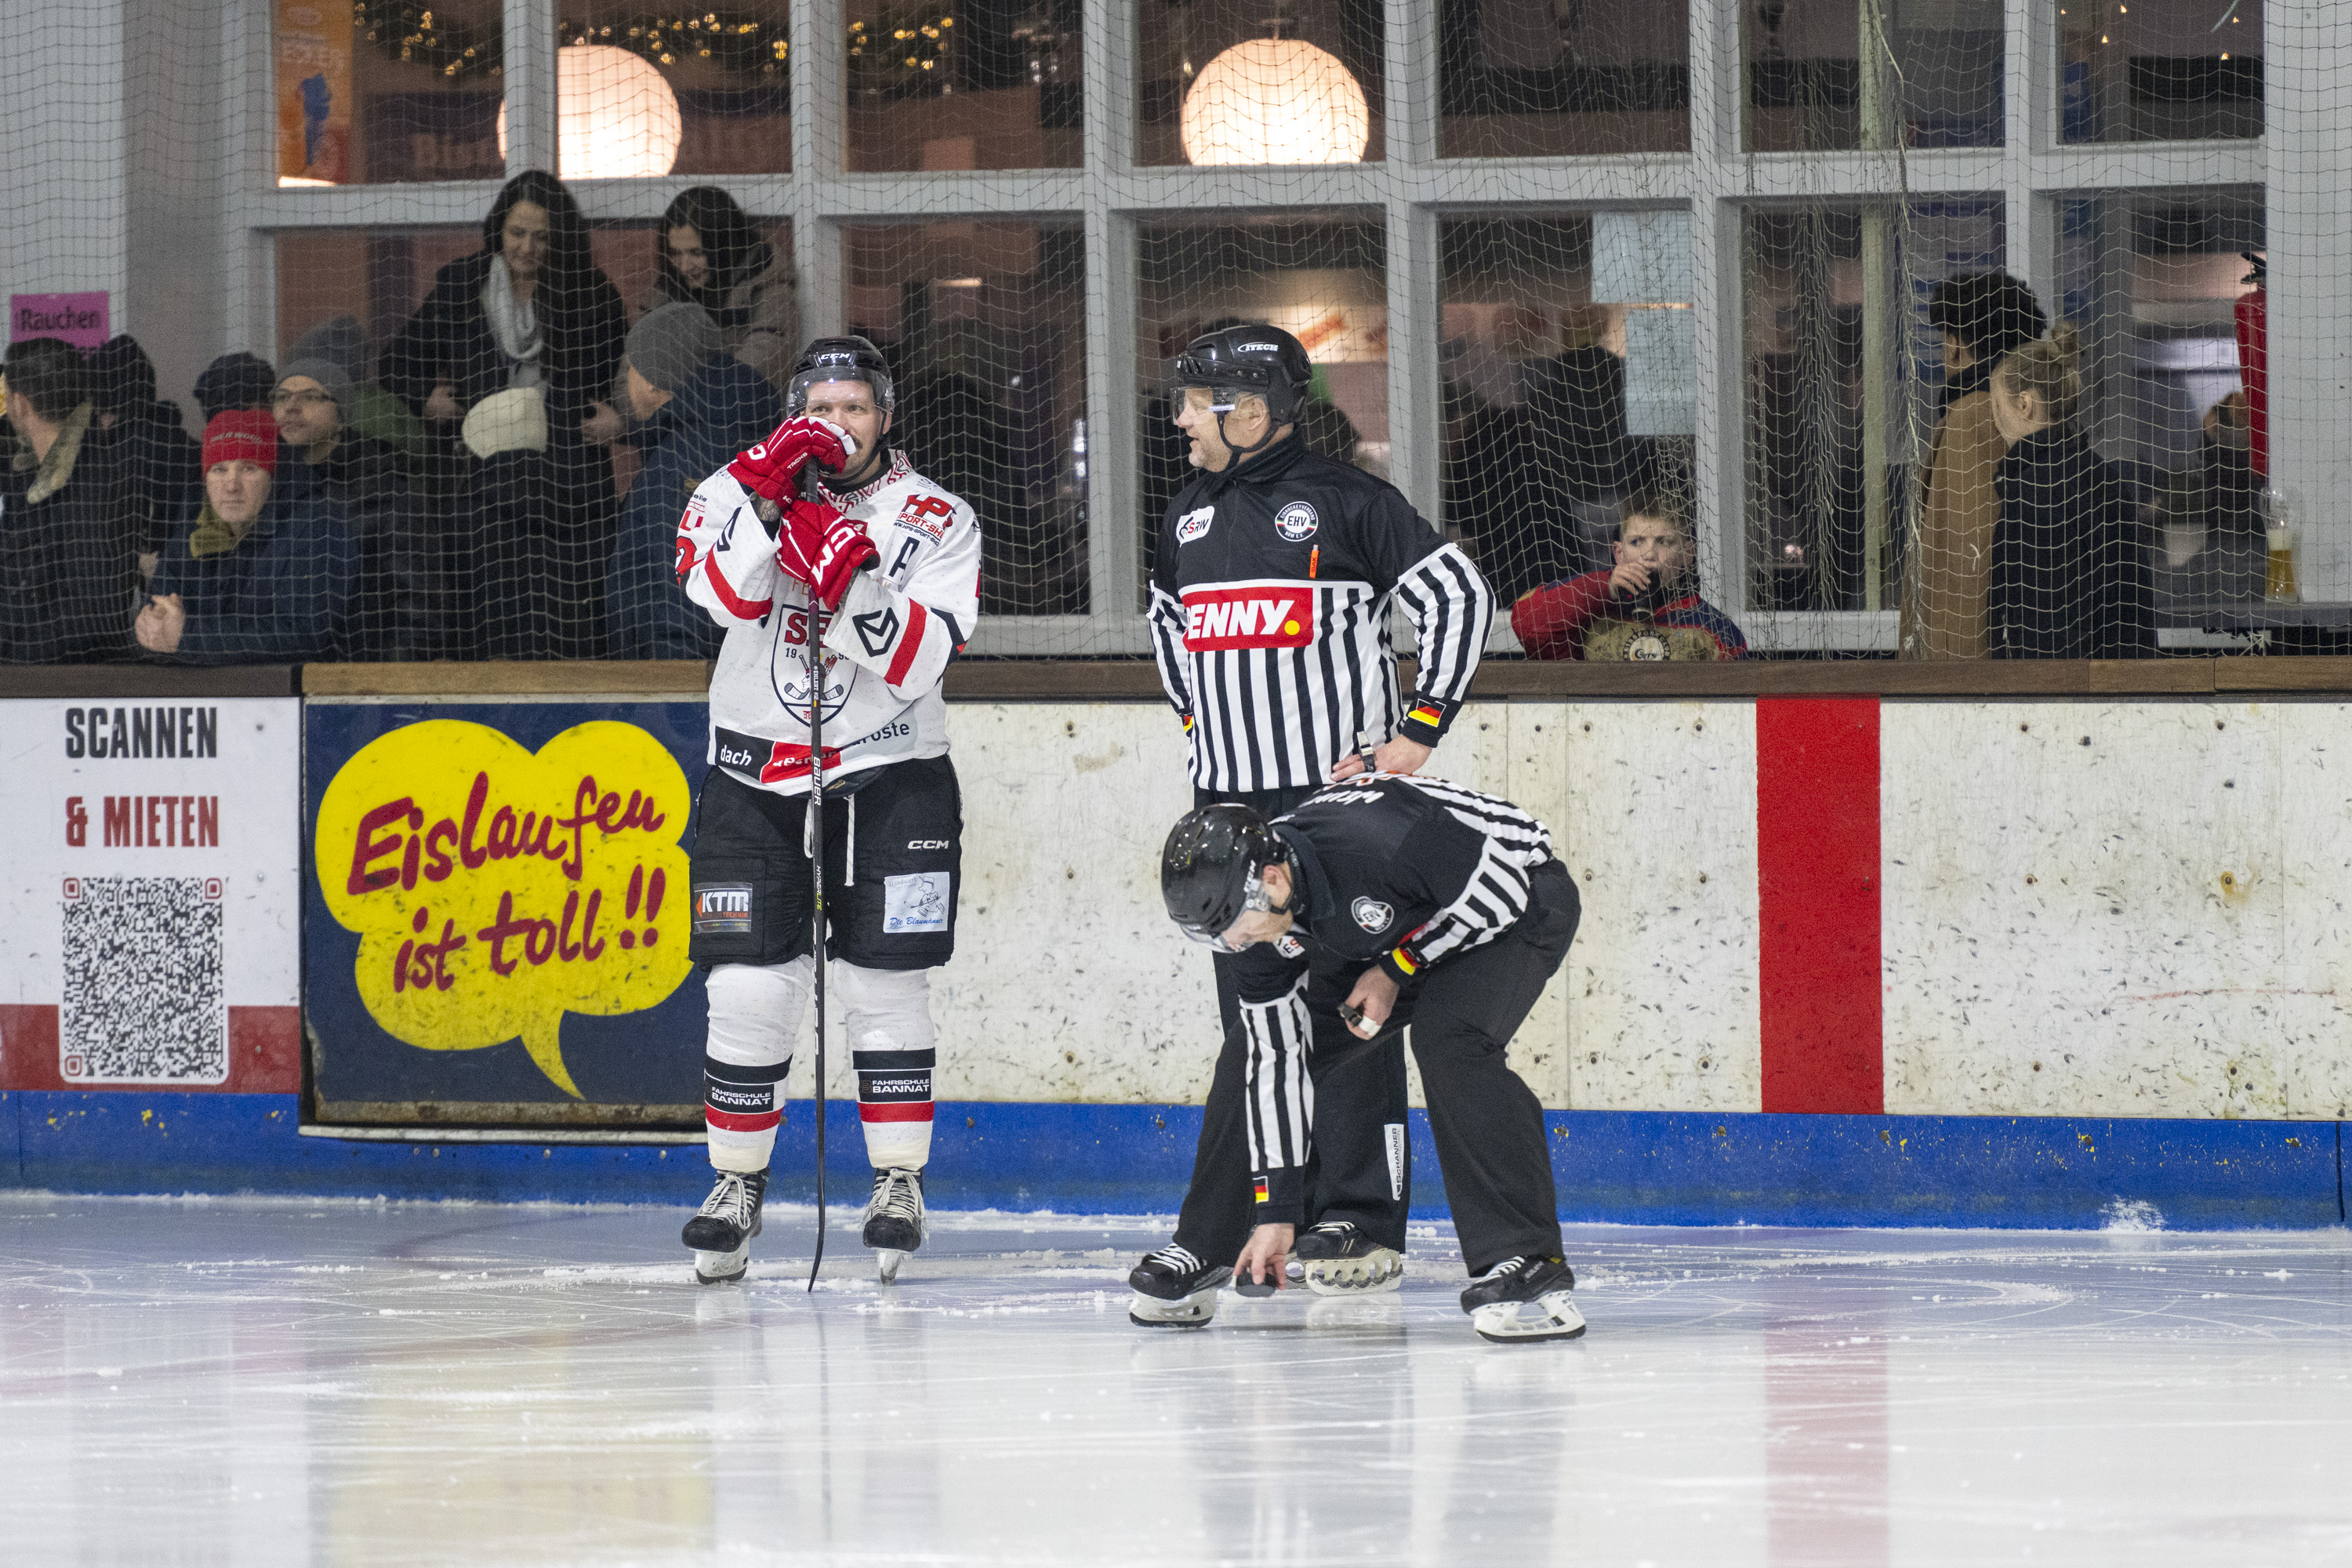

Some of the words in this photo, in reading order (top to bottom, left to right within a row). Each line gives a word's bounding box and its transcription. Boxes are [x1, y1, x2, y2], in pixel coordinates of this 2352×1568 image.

[20, 305, 102, 332] Rauchen
[787, 452, 808, 470] TACKS
[1287, 515, 1307, 527] EHV
[888, 535, 920, 581] A
[786, 647, 797, 659] 19
[65, 707, 217, 759] SCANNEN
[720, 745, 752, 766] dach
[66, 796, 88, 848] &
[103, 796, 219, 848] MIETEN
[347, 771, 666, 895] Eislaufen
[907, 840, 949, 850] CCM
[888, 877, 917, 887] Handwerk
[702, 891, 749, 913] KTM
[394, 906, 466, 993] ist
[711, 1092, 771, 1105] BANNAT
[712, 1086, 771, 1098] FAHRSCHULE
[872, 1084, 930, 1094] BANNAT
[1392, 1127, 1402, 1184] SCHANNER
